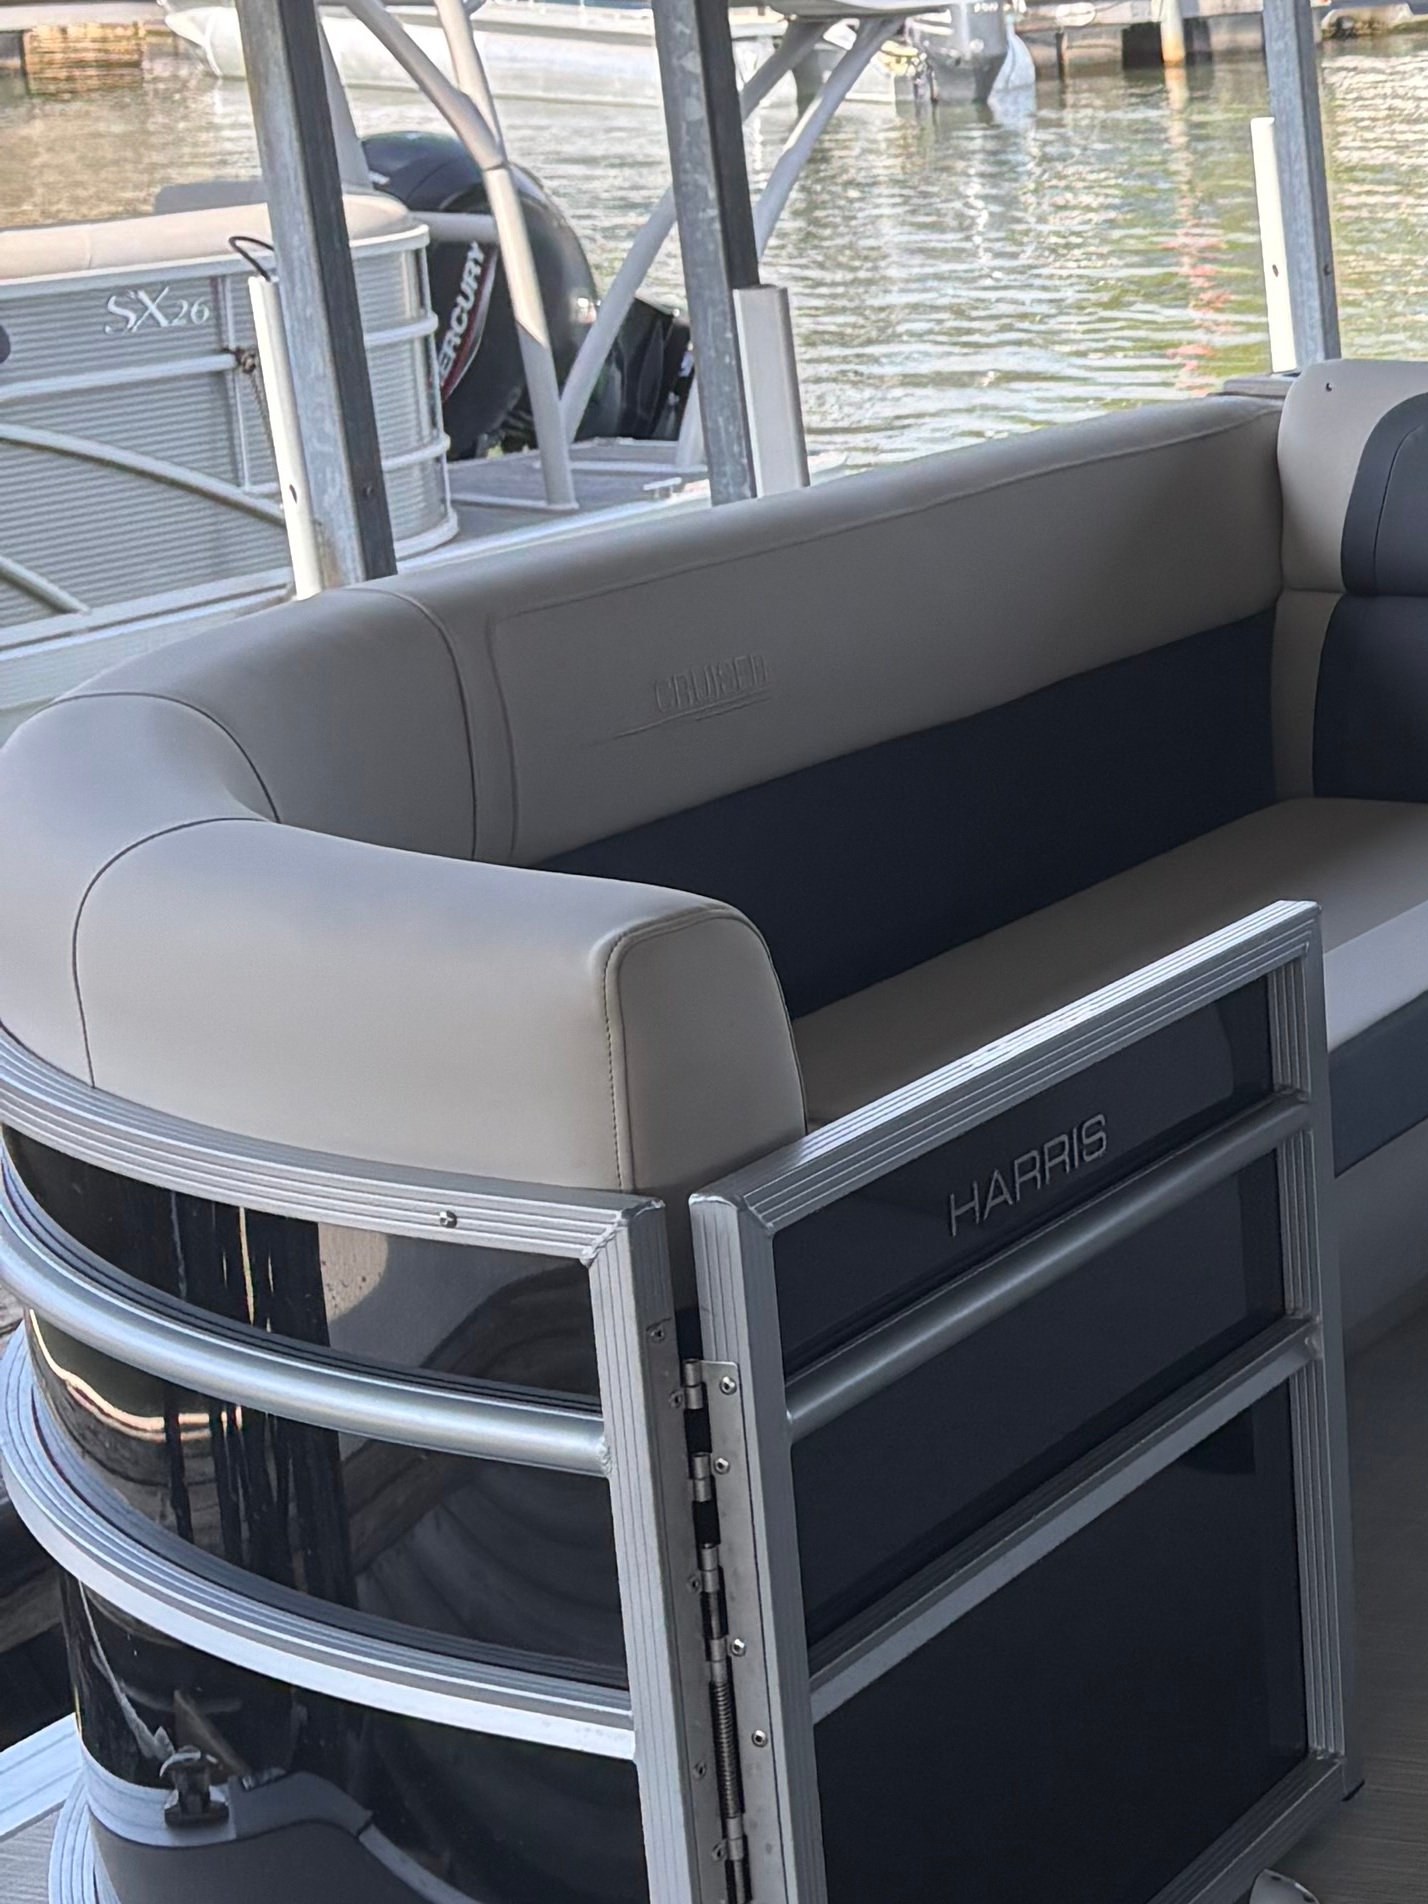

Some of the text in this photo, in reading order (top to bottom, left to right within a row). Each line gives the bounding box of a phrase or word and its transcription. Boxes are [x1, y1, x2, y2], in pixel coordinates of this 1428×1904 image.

[104, 286, 210, 335] SX26
[438, 240, 485, 387] ERCURY
[950, 1113, 1107, 1237] HARRIS
